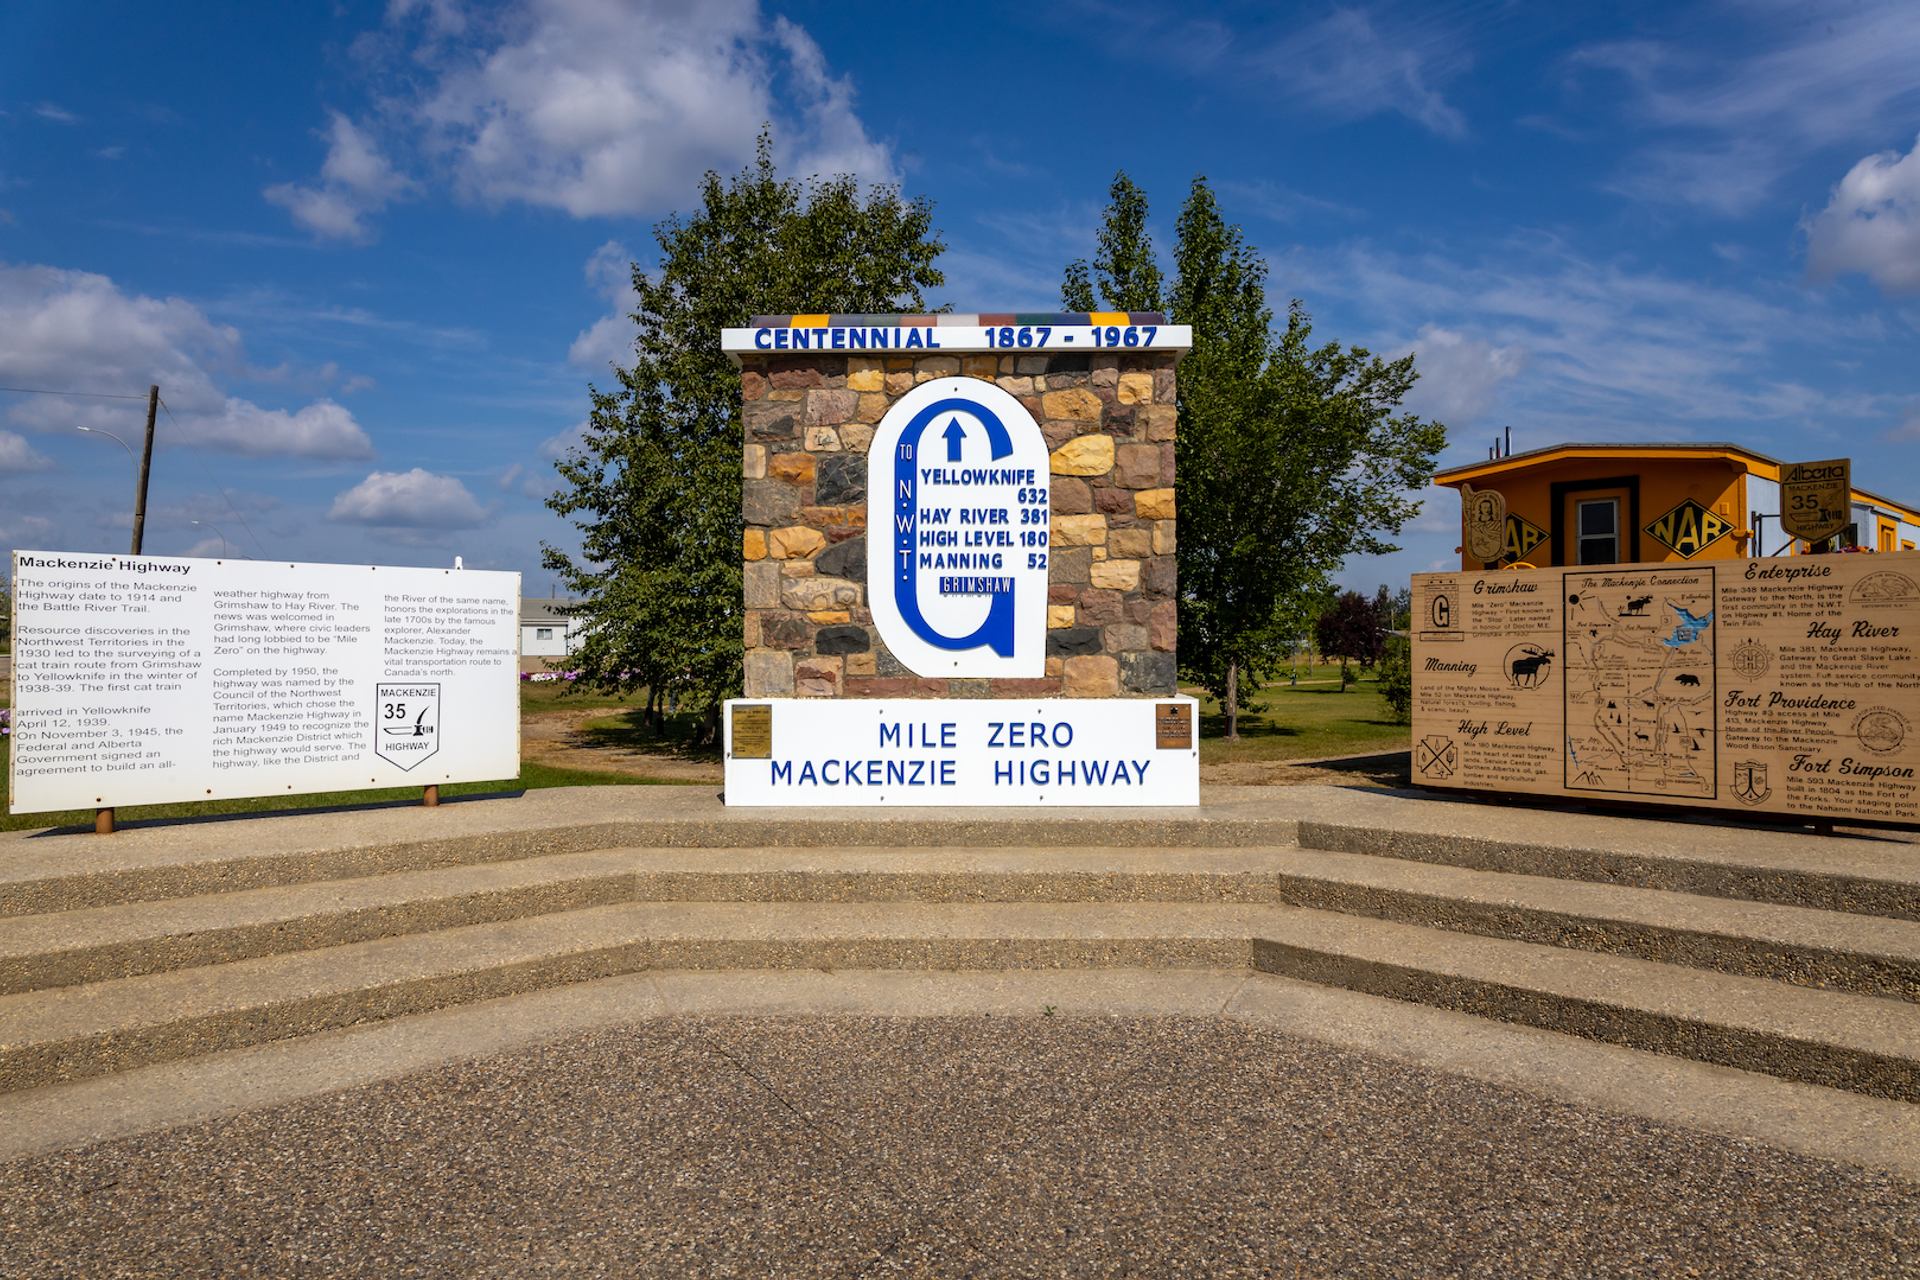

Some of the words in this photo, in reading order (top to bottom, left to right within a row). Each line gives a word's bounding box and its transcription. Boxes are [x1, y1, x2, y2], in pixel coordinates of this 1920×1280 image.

[754, 328, 940, 350] CENTENNIAL
[985, 328, 1051, 348] 1867
[1064, 334, 1074, 342] -
[1091, 326, 1158, 348] 1967
[900, 444, 912, 460] TO
[921, 469, 1035, 485] YELLOWKNIFE
[1785, 466, 1844, 481] Alberta
[1789, 482, 1839, 490] MACKENZIE
[1018, 488, 1047, 504] 632
[1792, 495, 1819, 510] 35
[920, 508, 951, 525] HAY
[960, 508, 1009, 525] RIVER
[1020, 508, 1048, 525] 381
[1654, 506, 1722, 550] NAR
[1796, 523, 1834, 532] HIGHWAY
[920, 531, 958, 547] HIGH
[964, 531, 1014, 547] LEVEL
[1020, 531, 1048, 547] 180
[1506, 519, 1539, 558] AR
[19, 557, 114, 570] Mackenzie
[119, 561, 191, 575] Highway
[920, 553, 1002, 570] MANNING
[1028, 554, 1047, 570] 52
[1745, 563, 1832, 582] Enterprise
[19, 578, 44, 587] The
[47, 581, 91, 590] origins
[94, 581, 106, 589] of
[133, 582, 197, 591] Mackenzie
[944, 577, 1010, 592] GRIMSHAW
[1474, 579, 1538, 595] Grimshaw
[1582, 578, 1597, 588] The
[1602, 577, 1646, 589] Mackenzie
[1650, 576, 1699, 585] Connection
[18, 590, 75, 601] Highway
[78, 592, 106, 600] date
[110, 593, 122, 601] to
[127, 593, 155, 601] 1914
[159, 594, 182, 602] and
[260, 591, 304, 600] highway
[306, 591, 330, 599] from
[401, 594, 426, 602] River
[384, 605, 416, 613] honors
[435, 606, 488, 615] explorations
[405, 615, 432, 623] 1700s
[434, 617, 446, 625] by
[17, 625, 80, 634] Resource
[1807, 622, 1842, 645] Hay
[1852, 620, 1900, 637] River
[89, 638, 148, 646] Territories
[141, 660, 202, 668] Grimshaw
[1425, 658, 1477, 677] Manning
[19, 684, 74, 692] 1938-39.
[79, 683, 104, 691] The
[107, 683, 130, 691] first
[212, 680, 258, 688] highway
[323, 678, 336, 687] by
[212, 691, 254, 699] Council
[256, 690, 267, 698] of
[289, 689, 341, 697] Northwest
[381, 689, 436, 697] MACKENZIE
[1724, 690, 1762, 708] Fort
[1768, 691, 1856, 710] Providence
[17, 708, 62, 716] arrived
[81, 706, 151, 714] Yellowknife
[384, 703, 406, 719] 35
[17, 731, 37, 740] On
[41, 729, 107, 739] November
[111, 728, 122, 737] 3,
[129, 727, 160, 736] 1945,
[164, 727, 183, 735] the
[879, 722, 957, 748] MILE
[988, 722, 1074, 748] ZERO
[1458, 720, 1488, 739] High
[1494, 721, 1533, 736] Level
[386, 742, 430, 751] HIGHWAY
[17, 753, 97, 763] Government
[101, 751, 142, 761] signed
[771, 760, 957, 786] MACKENZIE
[994, 760, 1151, 786] HIGHWAY
[1789, 755, 1832, 773] Fort
[1838, 758, 1915, 780] Simpson
